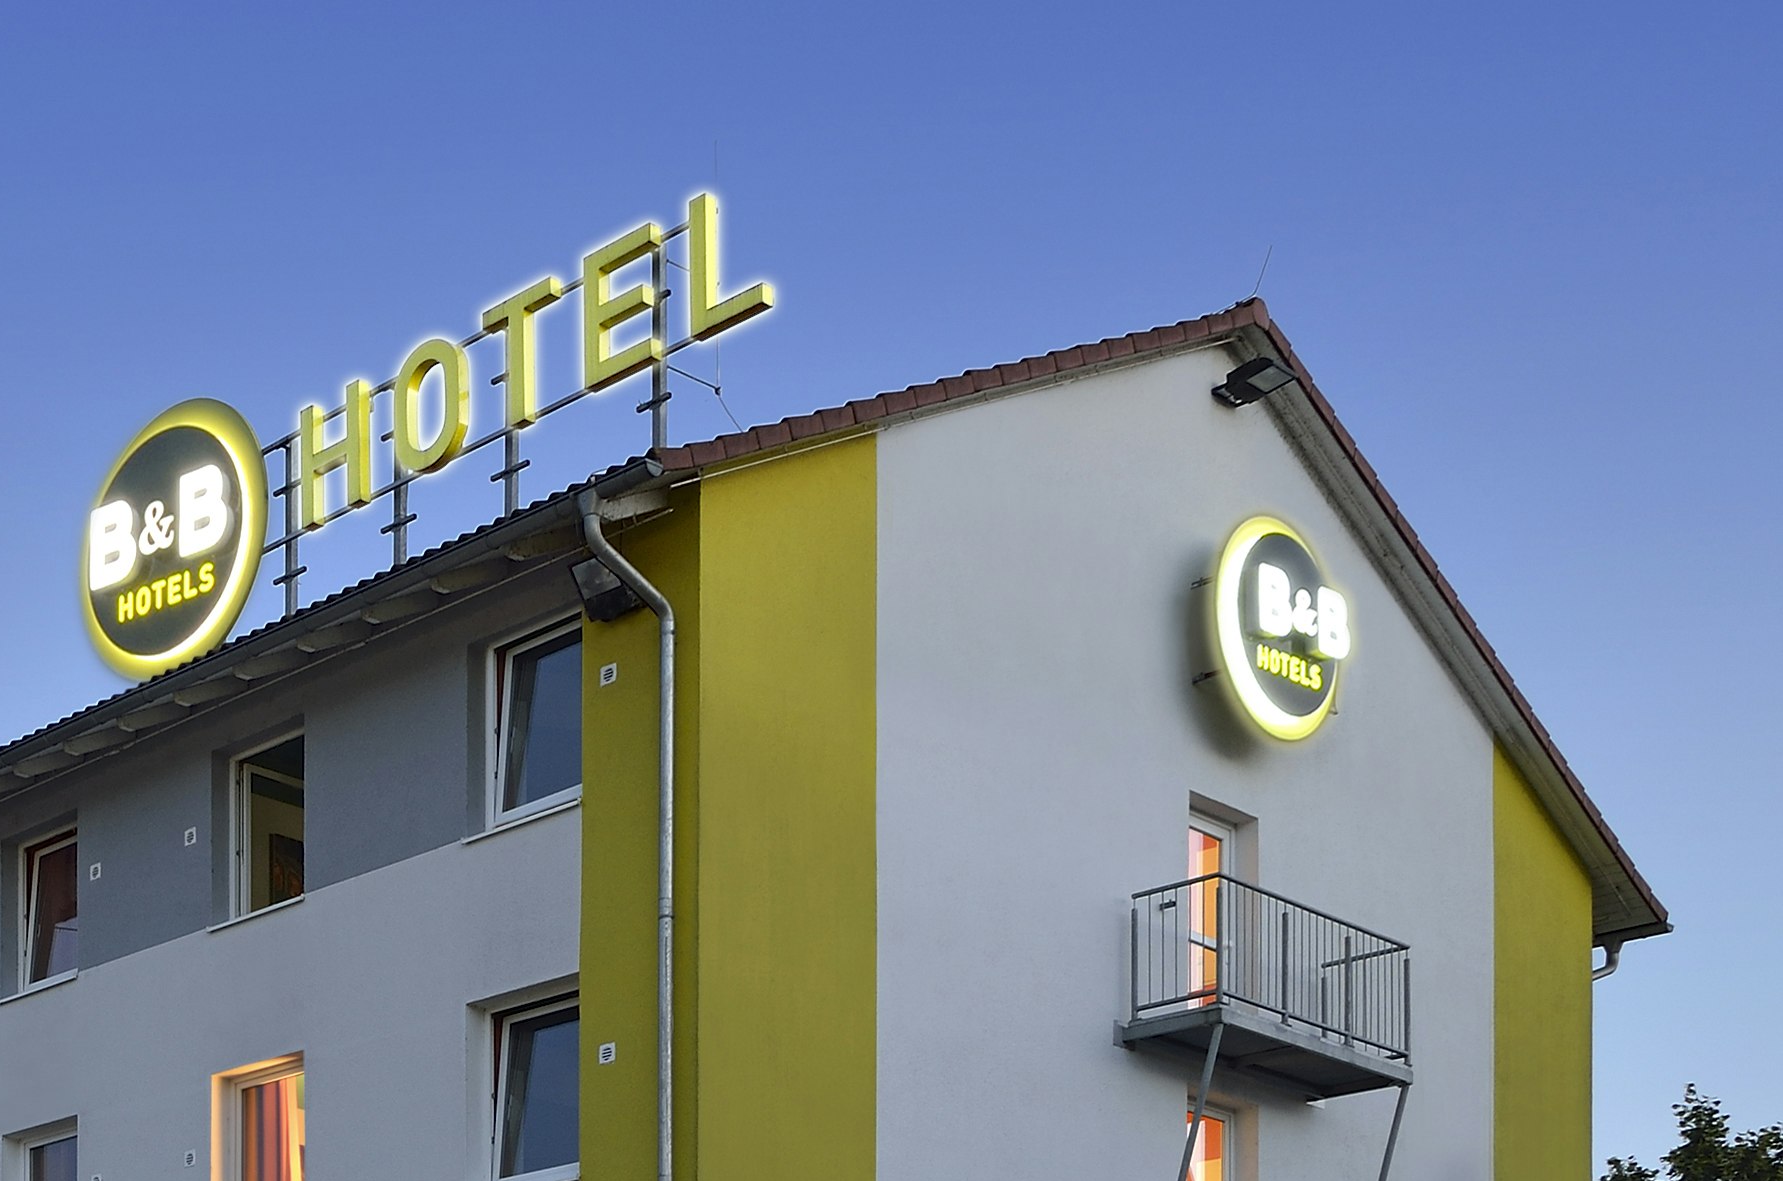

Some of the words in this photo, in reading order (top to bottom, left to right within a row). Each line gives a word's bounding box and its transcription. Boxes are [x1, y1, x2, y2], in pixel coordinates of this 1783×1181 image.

[301, 194, 773, 531] HOTEL
[89, 465, 230, 591] B&B
[117, 561, 216, 624] HOTELS
[1258, 561, 1351, 660] B&B
[1256, 643, 1323, 691] HOTELS
